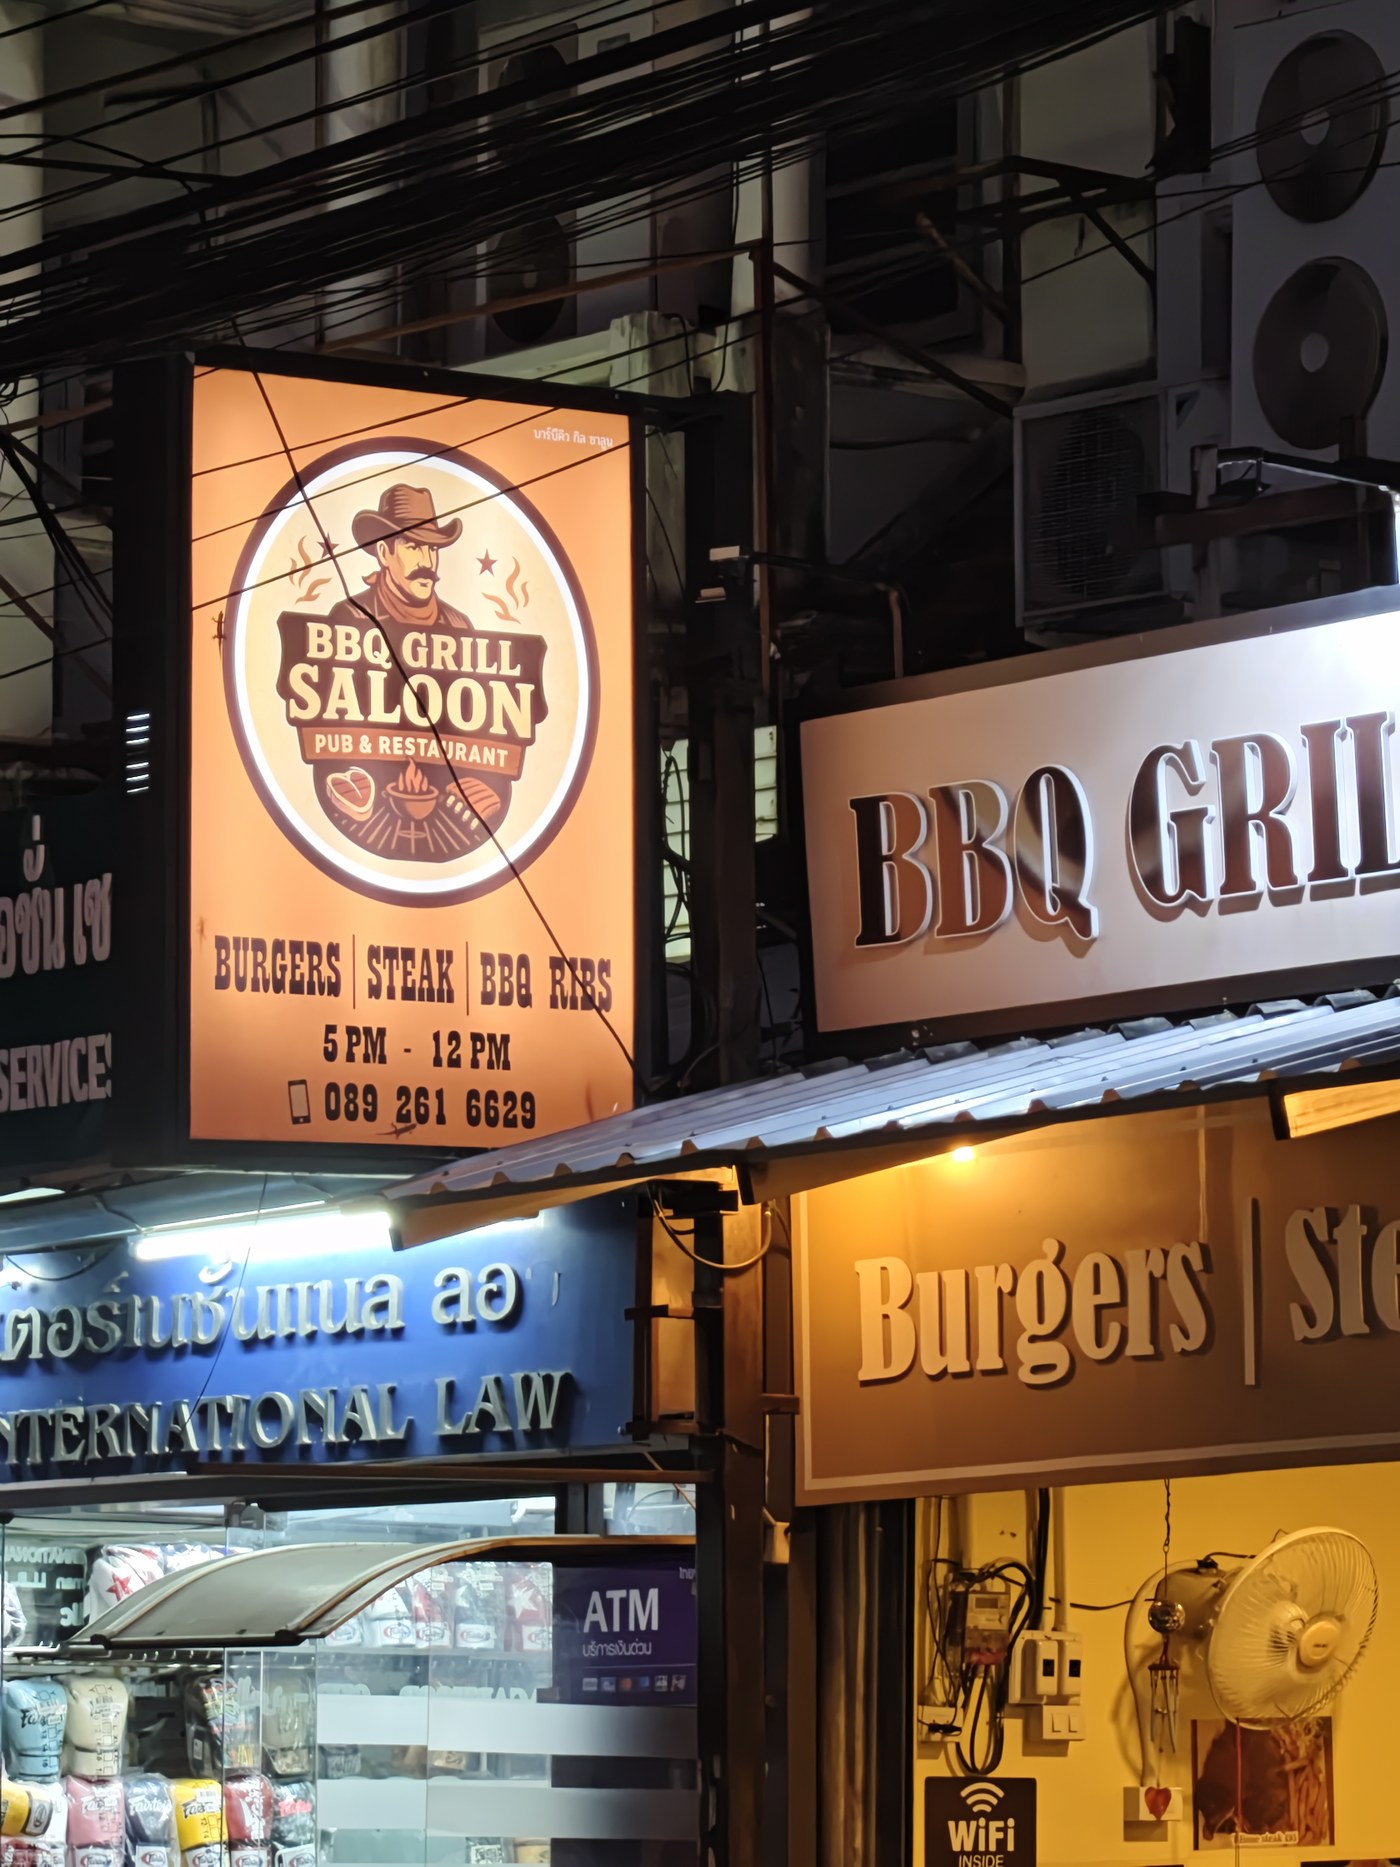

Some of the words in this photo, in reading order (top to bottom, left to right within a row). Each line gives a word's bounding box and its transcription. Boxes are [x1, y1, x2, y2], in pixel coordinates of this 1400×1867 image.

[306, 622, 392, 670] BBQ
[402, 631, 521, 677] GRILL
[289, 662, 535, 739] SALOON
[315, 733, 353, 753] PUB
[359, 737, 372, 754] &
[379, 736, 509, 768] RESTAURANT
[848, 763, 1099, 949] BBQ
[214, 934, 342, 998] BURGERS
[367, 943, 455, 1004] STEAK
[480, 951, 533, 1008] BBQ
[549, 955, 613, 1013] RIBS
[324, 1082, 378, 1123] 089
[396, 1086, 446, 1125] 261
[466, 1089, 536, 1130] 6629
[853, 1237, 1209, 1386] Burgers
[434, 1370, 572, 1436] LAW
[583, 1588, 659, 1633] ATM
[582, 1637, 652, 1657] บริการเงินด่วน
[947, 1817, 1015, 1852] WiFi
[958, 1854, 1005, 1867] INSIDE
